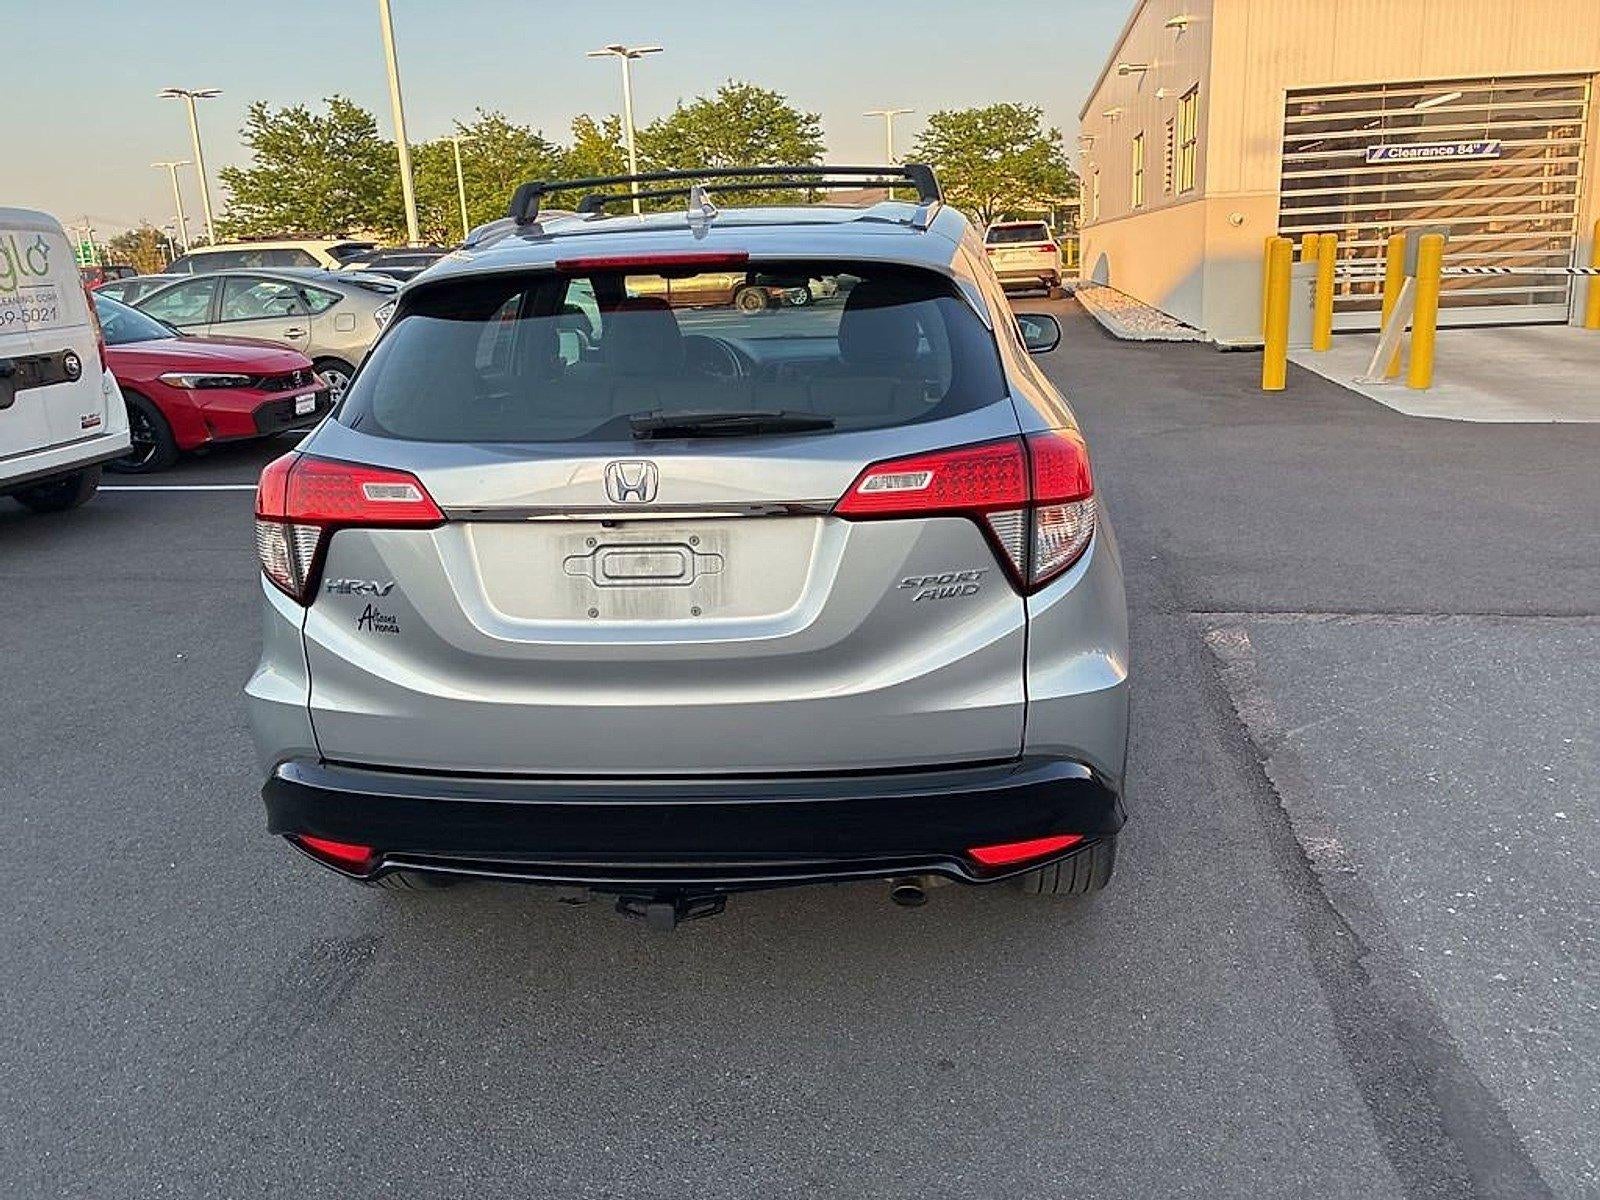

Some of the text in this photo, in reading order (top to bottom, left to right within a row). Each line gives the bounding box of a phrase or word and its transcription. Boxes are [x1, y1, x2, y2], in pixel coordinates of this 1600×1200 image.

[1387, 142, 1481, 158] Clearance 84"
[896, 567, 990, 589] SPORT
[325, 579, 394, 596] HR-V
[912, 582, 980, 602] AWD
